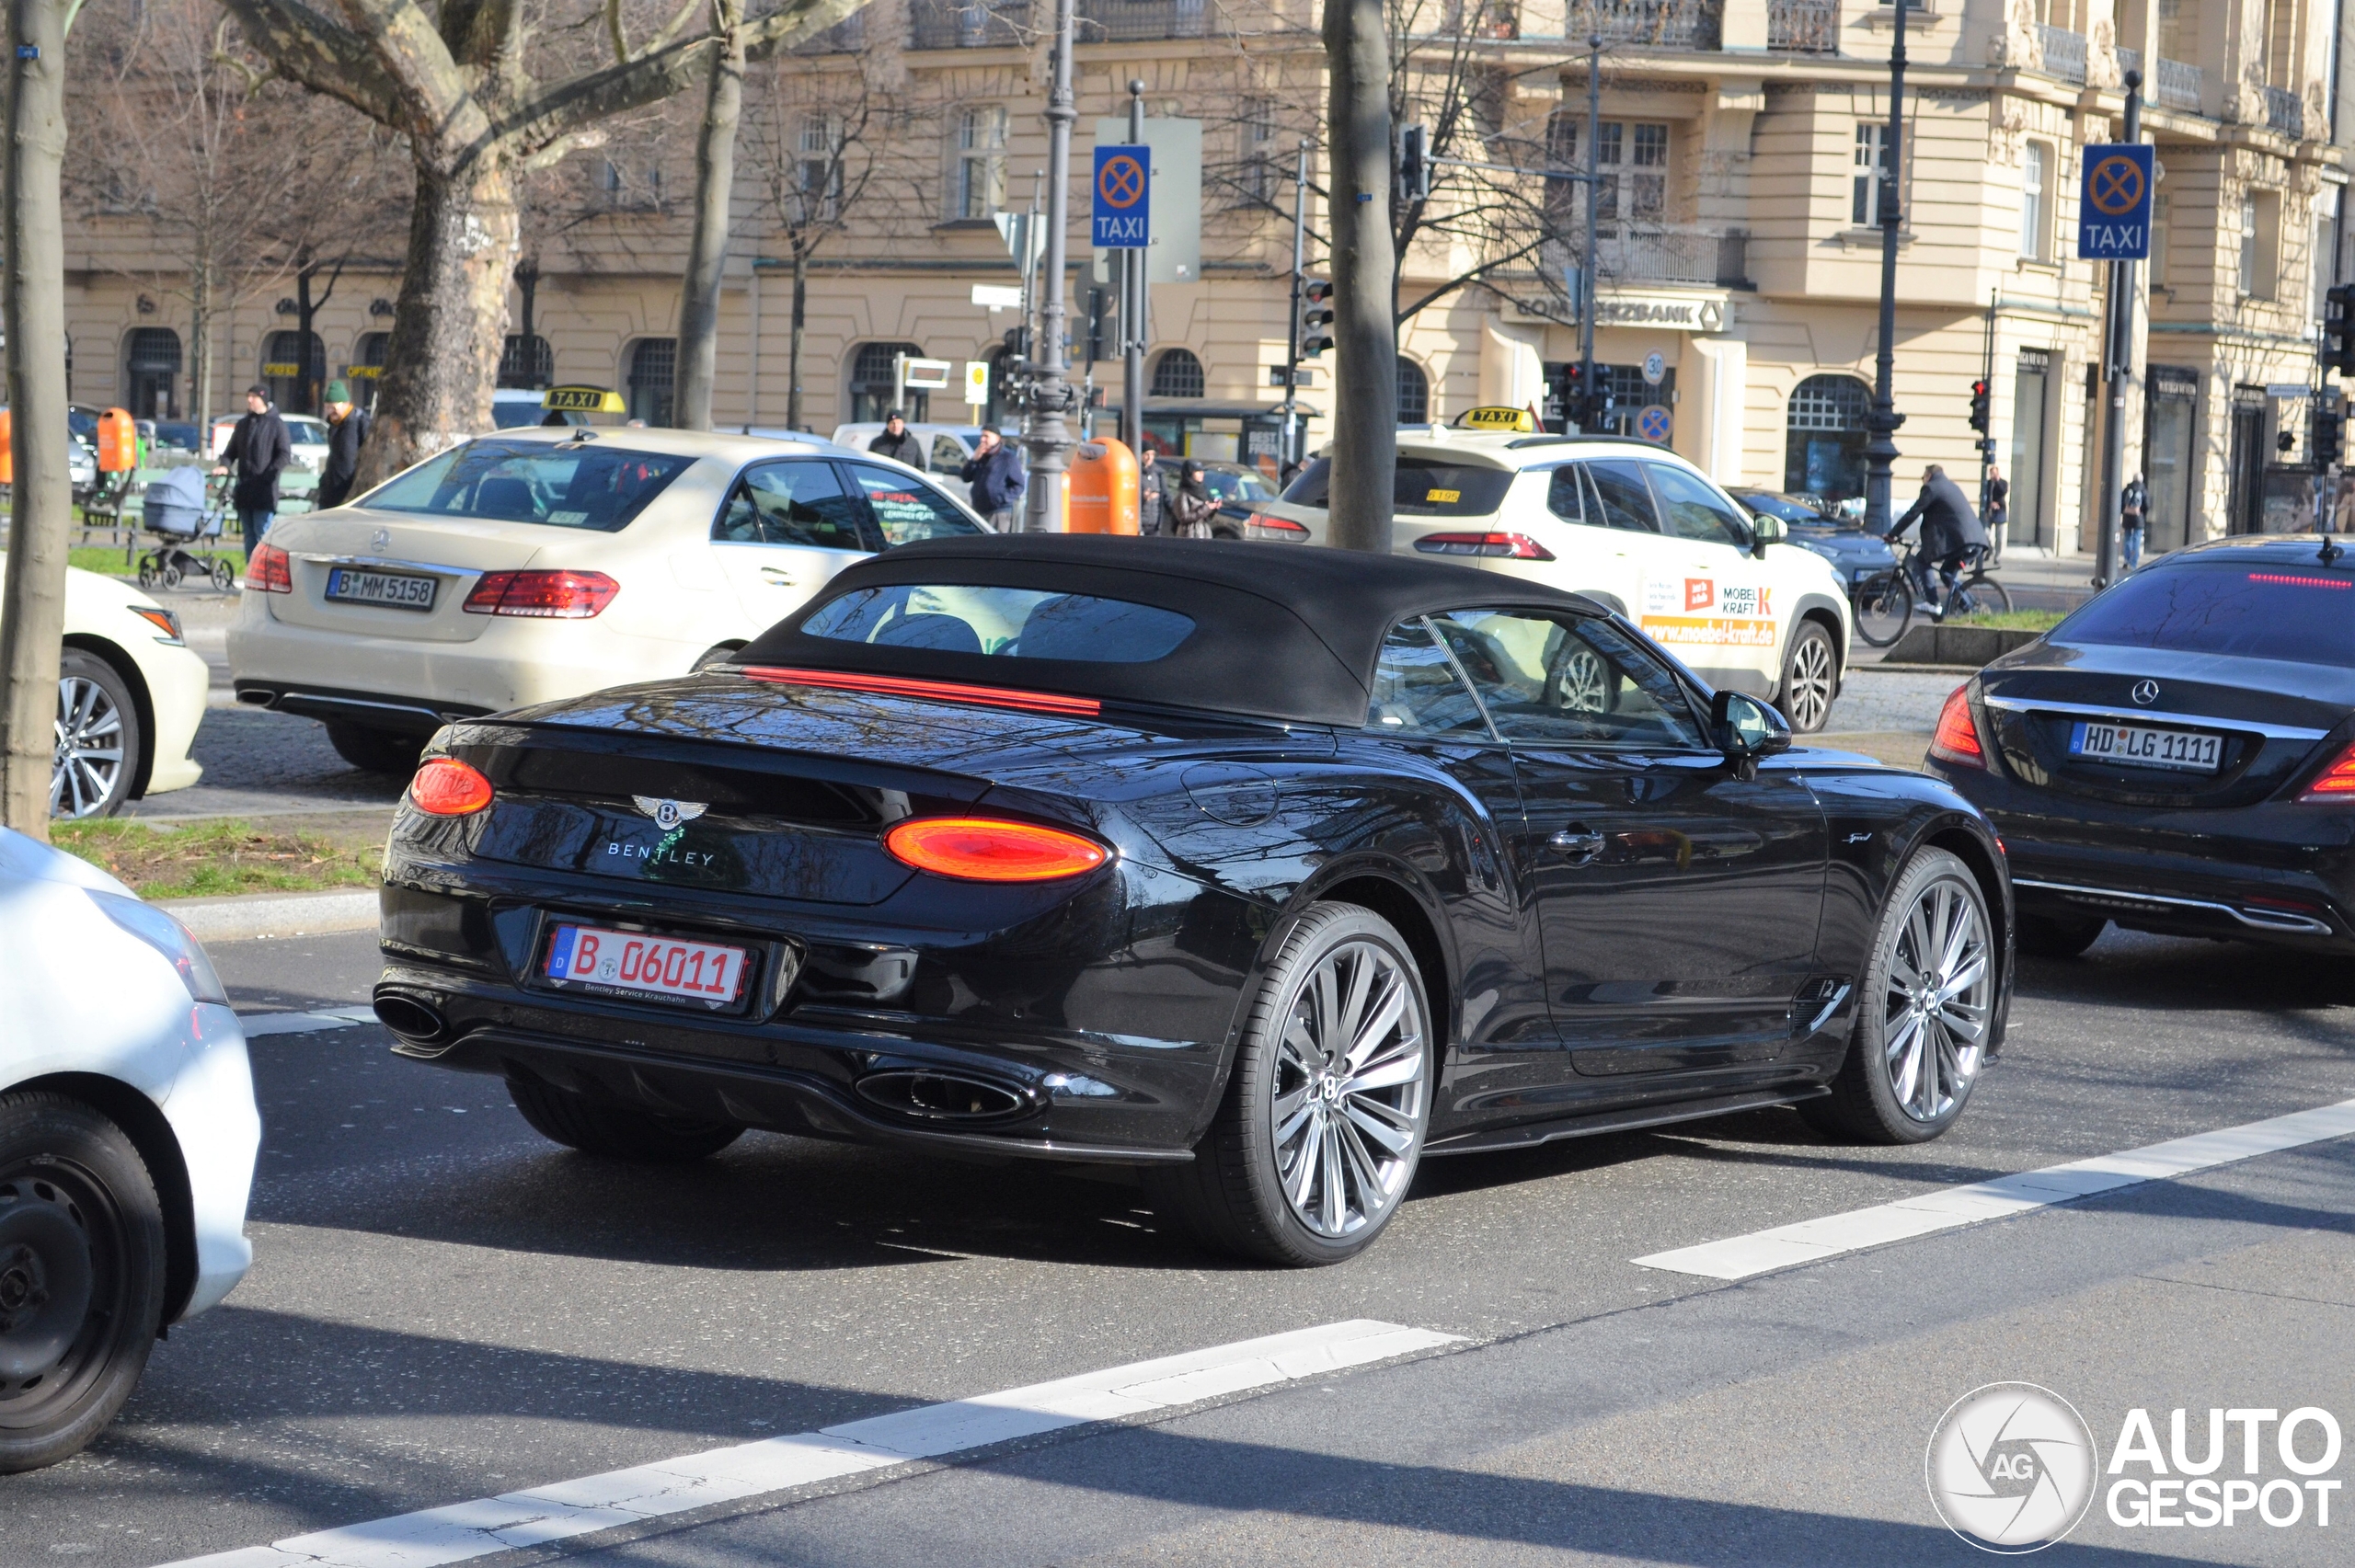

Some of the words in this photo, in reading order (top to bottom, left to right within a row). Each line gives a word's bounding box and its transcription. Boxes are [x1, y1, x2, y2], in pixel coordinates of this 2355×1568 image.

[1097, 216, 1144, 238] TAXI
[2085, 224, 2142, 249] TAXI
[1517, 299, 1694, 323] COMERZBANK
[1648, 358, 1662, 374] 30
[557, 392, 596, 406] TAXI
[1478, 411, 1514, 422] TAXI
[1248, 431, 1277, 442] BEST
[1428, 491, 1458, 501] 6195
[338, 573, 350, 594] B
[361, 576, 385, 598] MM
[386, 578, 431, 602] 5158
[1722, 601, 1754, 615] KRAFT
[1644, 620, 1774, 645] www.moebel-kraft.de
[2085, 726, 2115, 752] HD
[2127, 731, 2157, 757] LG
[2161, 735, 2217, 764] 1111
[608, 842, 714, 865] BENTLEY
[555, 957, 564, 968] D
[574, 934, 600, 975] B
[619, 941, 728, 994] 06011
[584, 983, 614, 995] Bentley
[615, 988, 643, 999] Service
[645, 991, 686, 1004] Krauthahn
